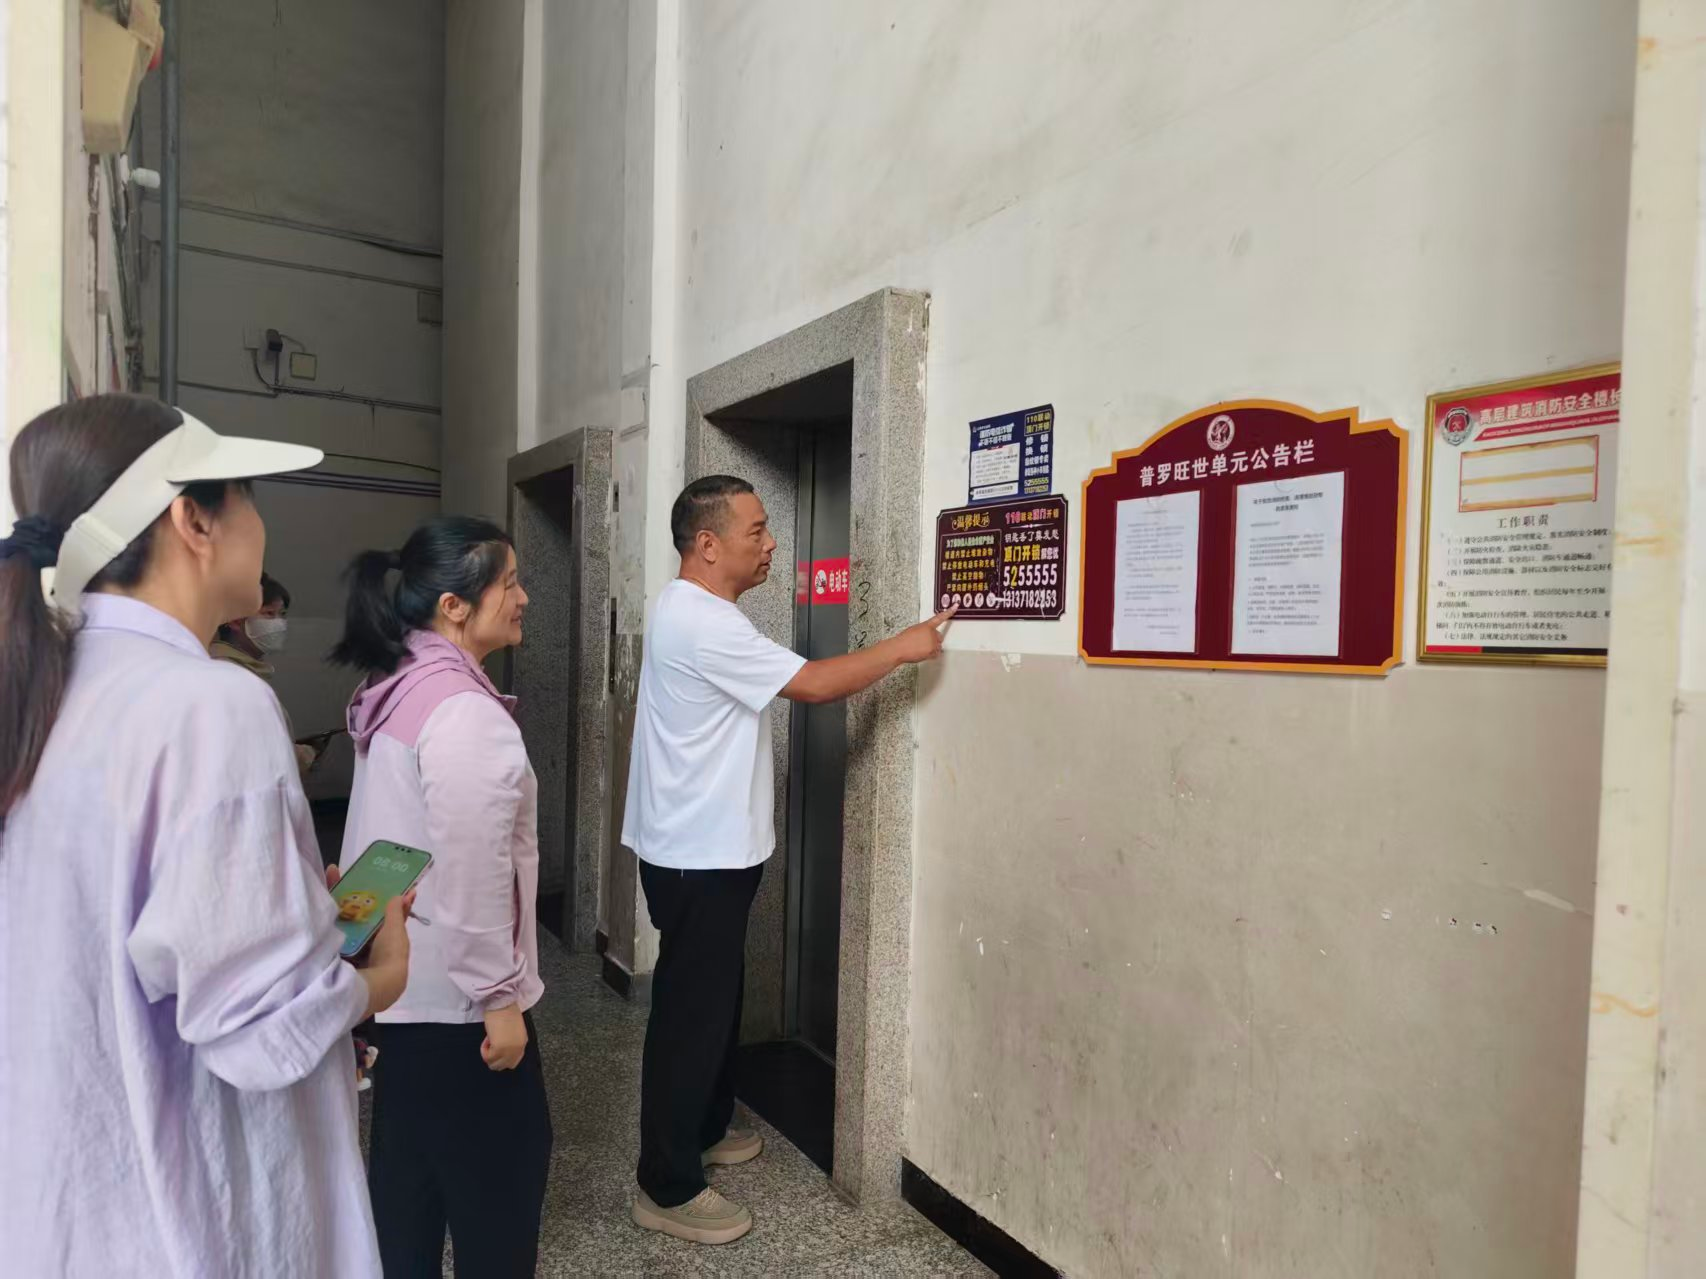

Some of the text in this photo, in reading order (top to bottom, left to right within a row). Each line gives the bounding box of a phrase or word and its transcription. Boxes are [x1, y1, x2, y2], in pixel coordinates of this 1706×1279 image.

[1139, 439, 1315, 488] 普罗旺世单元公告栏
[1497, 514, 1549, 529] 工作职责
[829, 569, 848, 593] 电动车
[1003, 563, 1058, 588] 5255555
